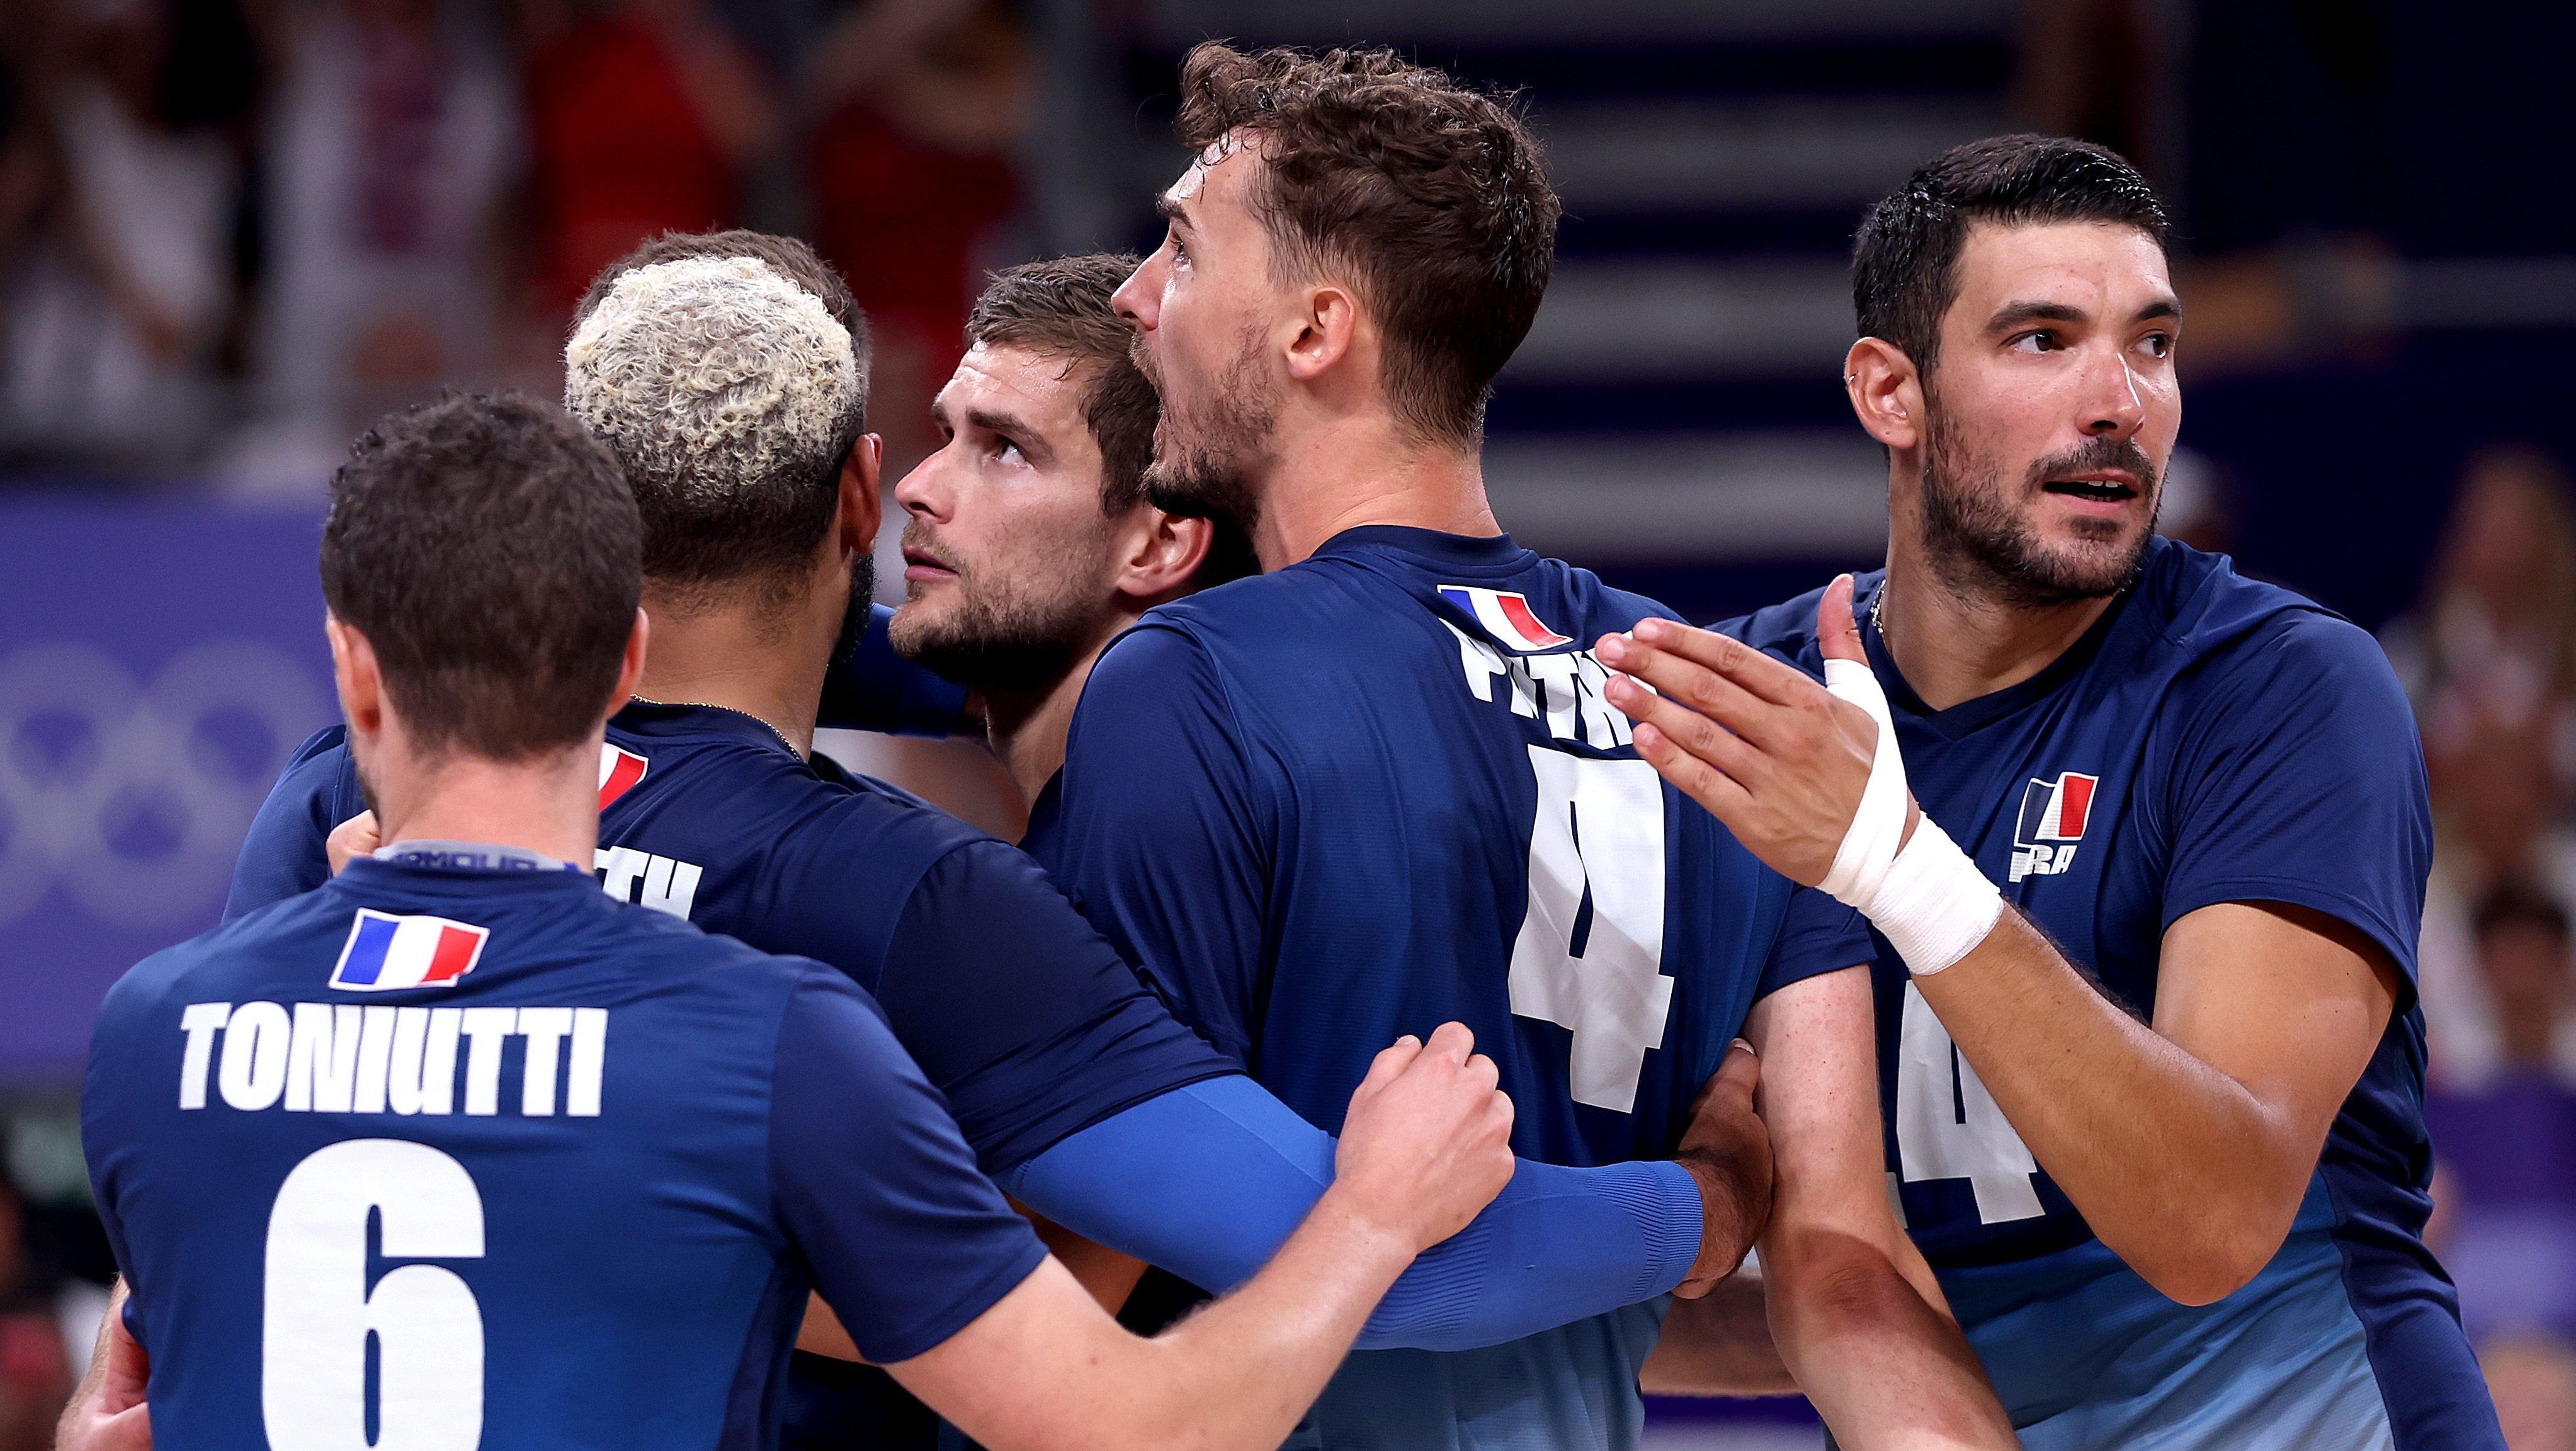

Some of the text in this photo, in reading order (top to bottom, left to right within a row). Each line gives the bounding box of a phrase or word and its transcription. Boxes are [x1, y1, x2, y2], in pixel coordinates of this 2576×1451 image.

[180, 1001, 607, 1117] TONIUTTI
[1508, 743, 1675, 1113] 4
[1887, 980, 2046, 1229] 4
[261, 1138, 485, 1451] 6
